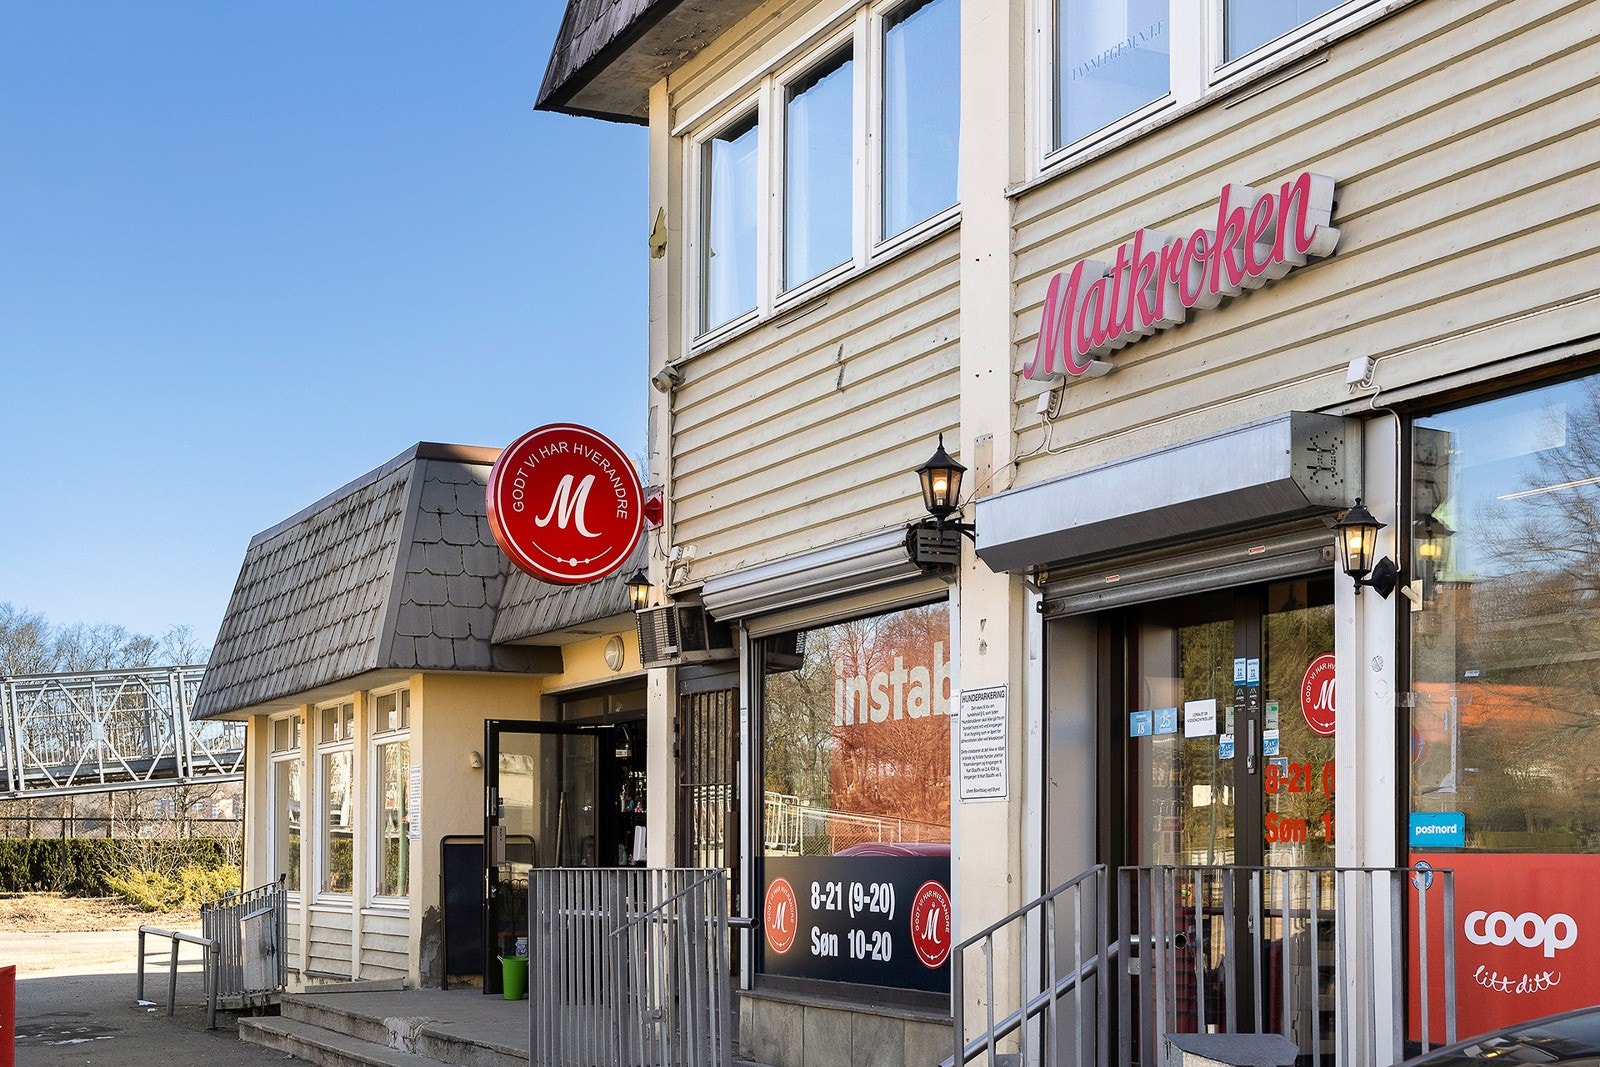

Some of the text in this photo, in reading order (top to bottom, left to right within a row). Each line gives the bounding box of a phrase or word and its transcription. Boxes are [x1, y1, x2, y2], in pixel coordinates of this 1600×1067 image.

[1023, 171, 1319, 381] Matkroken
[512, 441, 628, 520] GODT VI HAR HVERANDRE
[534, 474, 602, 538] M
[961, 690, 1005, 703] HUNDEPARKERING
[1265, 761, 1312, 794] 8-21
[1264, 811, 1306, 845] Søn
[1415, 823, 1457, 836] postnord
[771, 901, 788, 934] M
[811, 881, 896, 921] 8-21 (9-20)
[810, 925, 892, 962] Søn 10-20
[1464, 910, 1578, 958] coop
[1473, 964, 1561, 995] litt ditt
